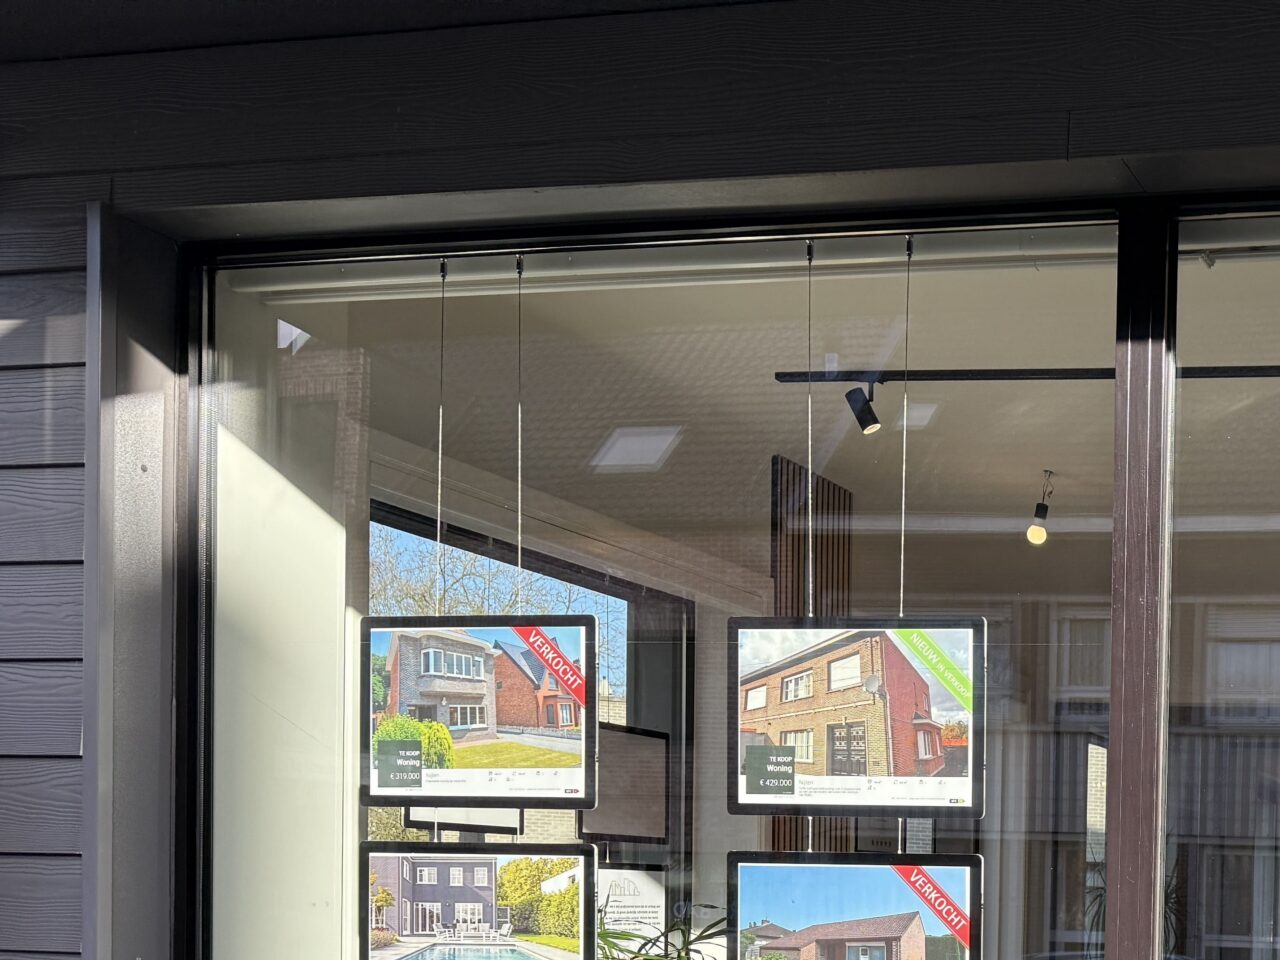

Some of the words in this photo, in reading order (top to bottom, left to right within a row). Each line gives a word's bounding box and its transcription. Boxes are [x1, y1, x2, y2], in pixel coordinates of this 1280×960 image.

[910, 632, 941, 664] NIEUW
[529, 630, 583, 689] VERKOCHT
[397, 758, 420, 767] Woning
[766, 764, 793, 773] Woning
[395, 772, 420, 780] 319.000
[759, 778, 764, 786] €
[765, 778, 792, 786] 429.000
[910, 868, 967, 930] VERKOCHT
